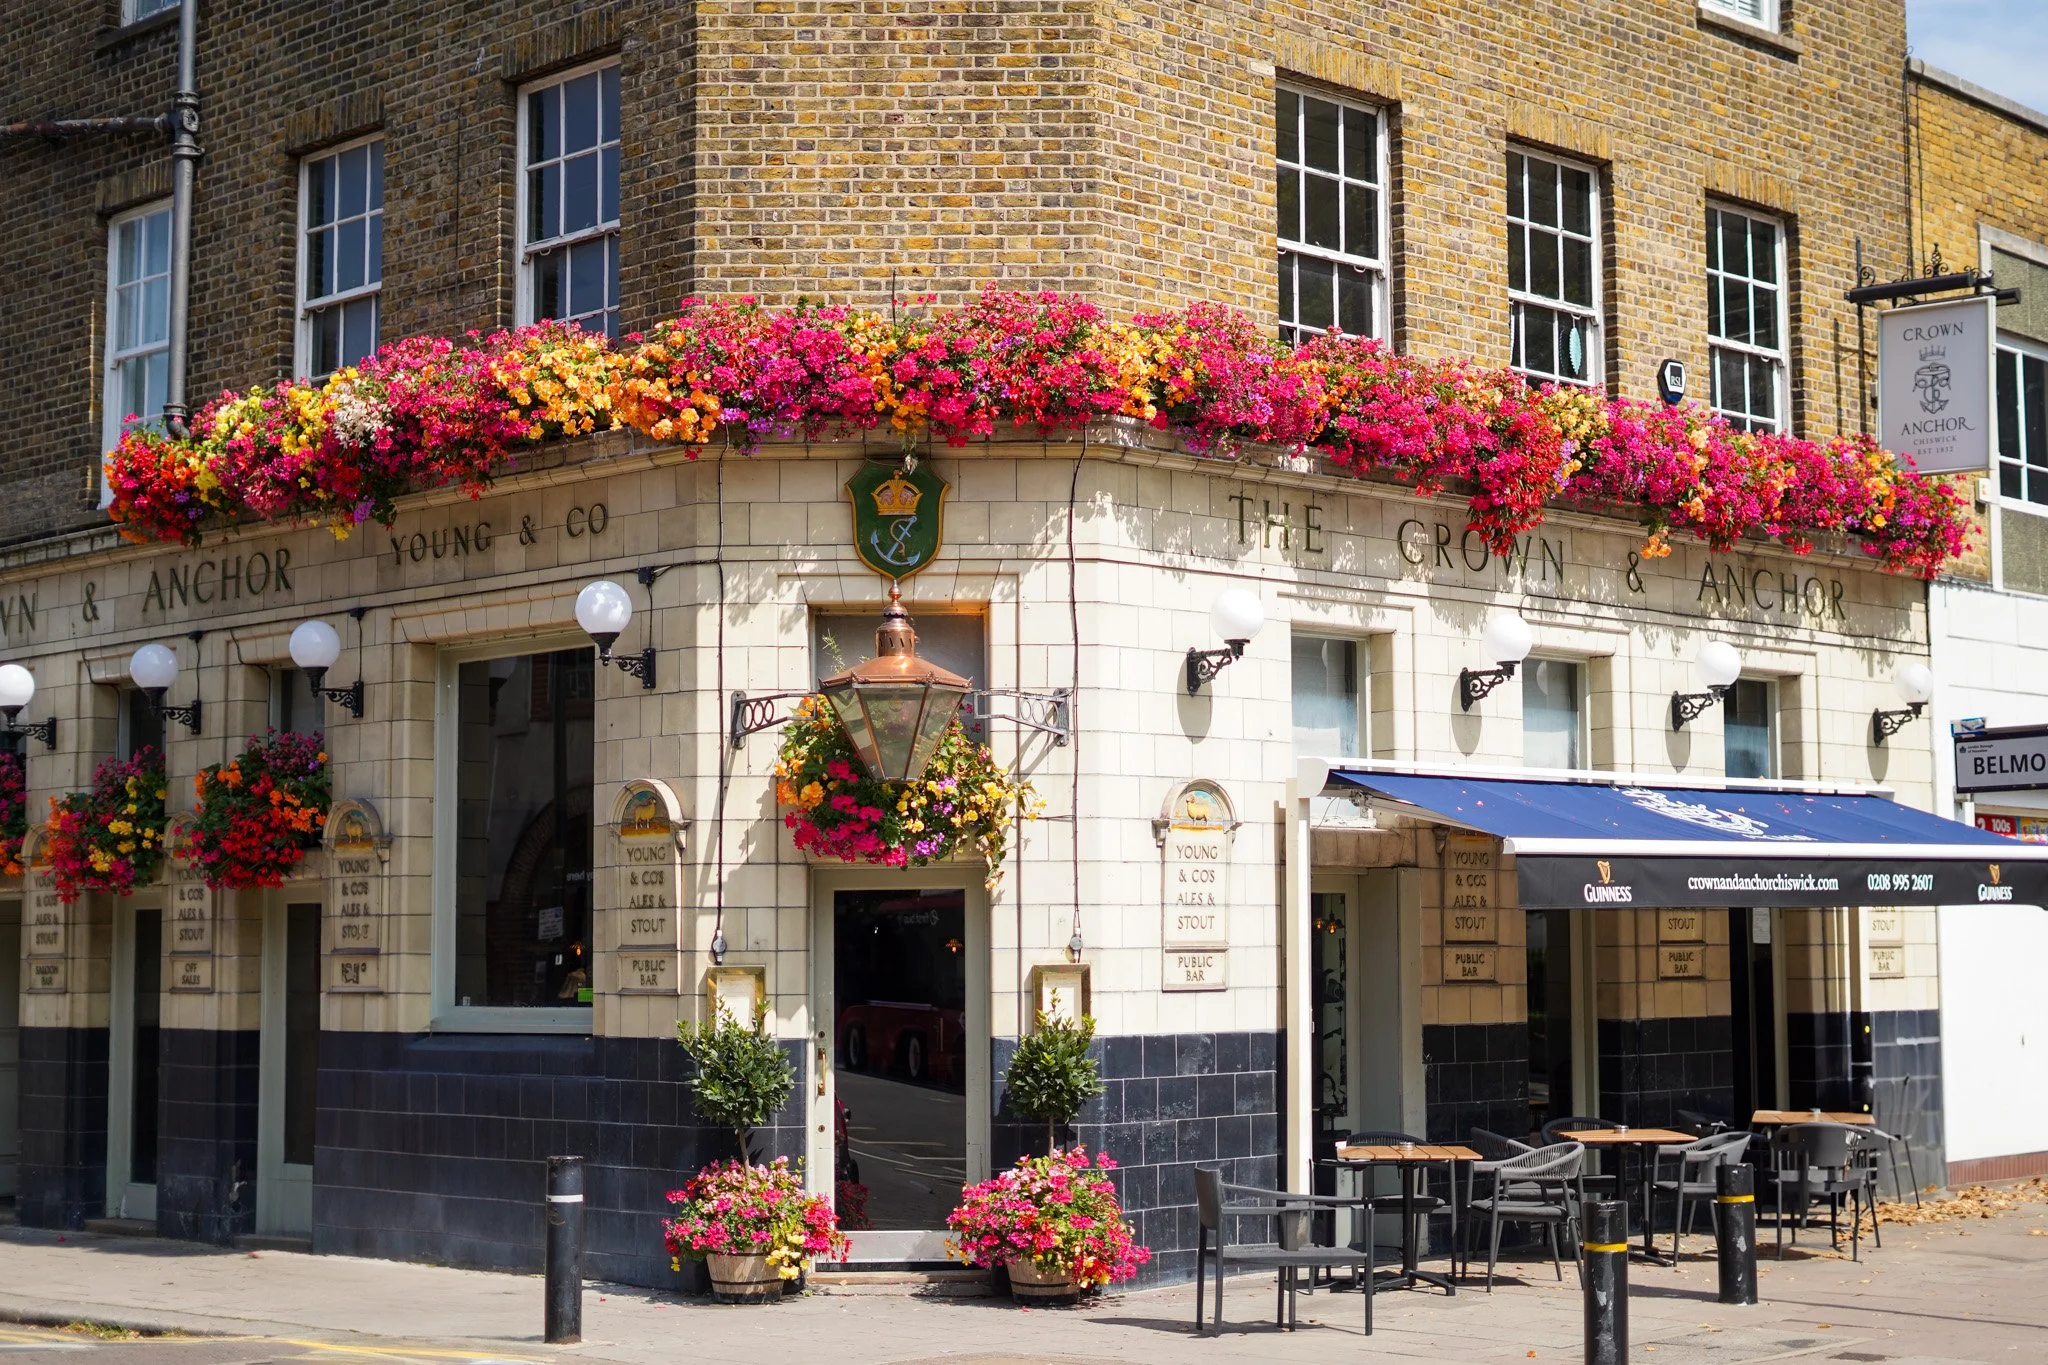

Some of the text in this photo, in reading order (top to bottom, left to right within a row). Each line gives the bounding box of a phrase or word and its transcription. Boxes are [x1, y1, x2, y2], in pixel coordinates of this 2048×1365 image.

[1903, 322, 1964, 341] CROWN
[1901, 416, 1976, 436] ANCHOR
[1913, 436, 1957, 445] CHISWICK
[390, 503, 608, 565] YOUNG & CO
[1229, 494, 1846, 620] THE CROWN & ANCHOR
[82, 581, 100, 623] &
[142, 548, 292, 613] ANCHOR
[1974, 753, 2046, 775] BELMO
[1992, 818, 2011, 832] 100s
[627, 847, 666, 861] YOUNG
[1176, 845, 1218, 860] YOUNG
[1454, 852, 1489, 865] YOUNG
[339, 860, 369, 873] YOUNG
[630, 871, 638, 885] &
[1178, 869, 1187, 882] &
[1456, 874, 1463, 887] &
[1688, 873, 1840, 891] crownandanchorchiswick.com
[342, 883, 349, 895] &
[1867, 874, 1934, 891] 0208 995 2607
[1177, 893, 1216, 906] ALES &
[1584, 884, 1632, 902] GUINNESS
[1978, 884, 2013, 902] GUINNESS
[629, 895, 666, 908] ALES &
[1454, 896, 1487, 908] ALES &
[341, 903, 360, 916] ALES
[631, 918, 666, 933] STOUT
[1178, 916, 1215, 929] STOUT
[1455, 917, 1486, 929] STOUT
[1668, 918, 1695, 930] STOUT
[1872, 920, 1895, 931] STOUT
[179, 928, 204, 941] STOUT
[342, 925, 369, 939] STOUT
[1178, 956, 1213, 968] PUBLIC
[1455, 953, 1485, 964] PUBLIC
[1668, 952, 1694, 962] PUBLIC
[1873, 951, 1894, 960] PUBLIC
[632, 960, 666, 972] PUBLIC
[1462, 966, 1478, 976] BAR
[1675, 964, 1688, 974] BAR
[1878, 962, 1890, 971] BAR
[640, 974, 658, 986] BAR
[1186, 970, 1205, 981] BAR
